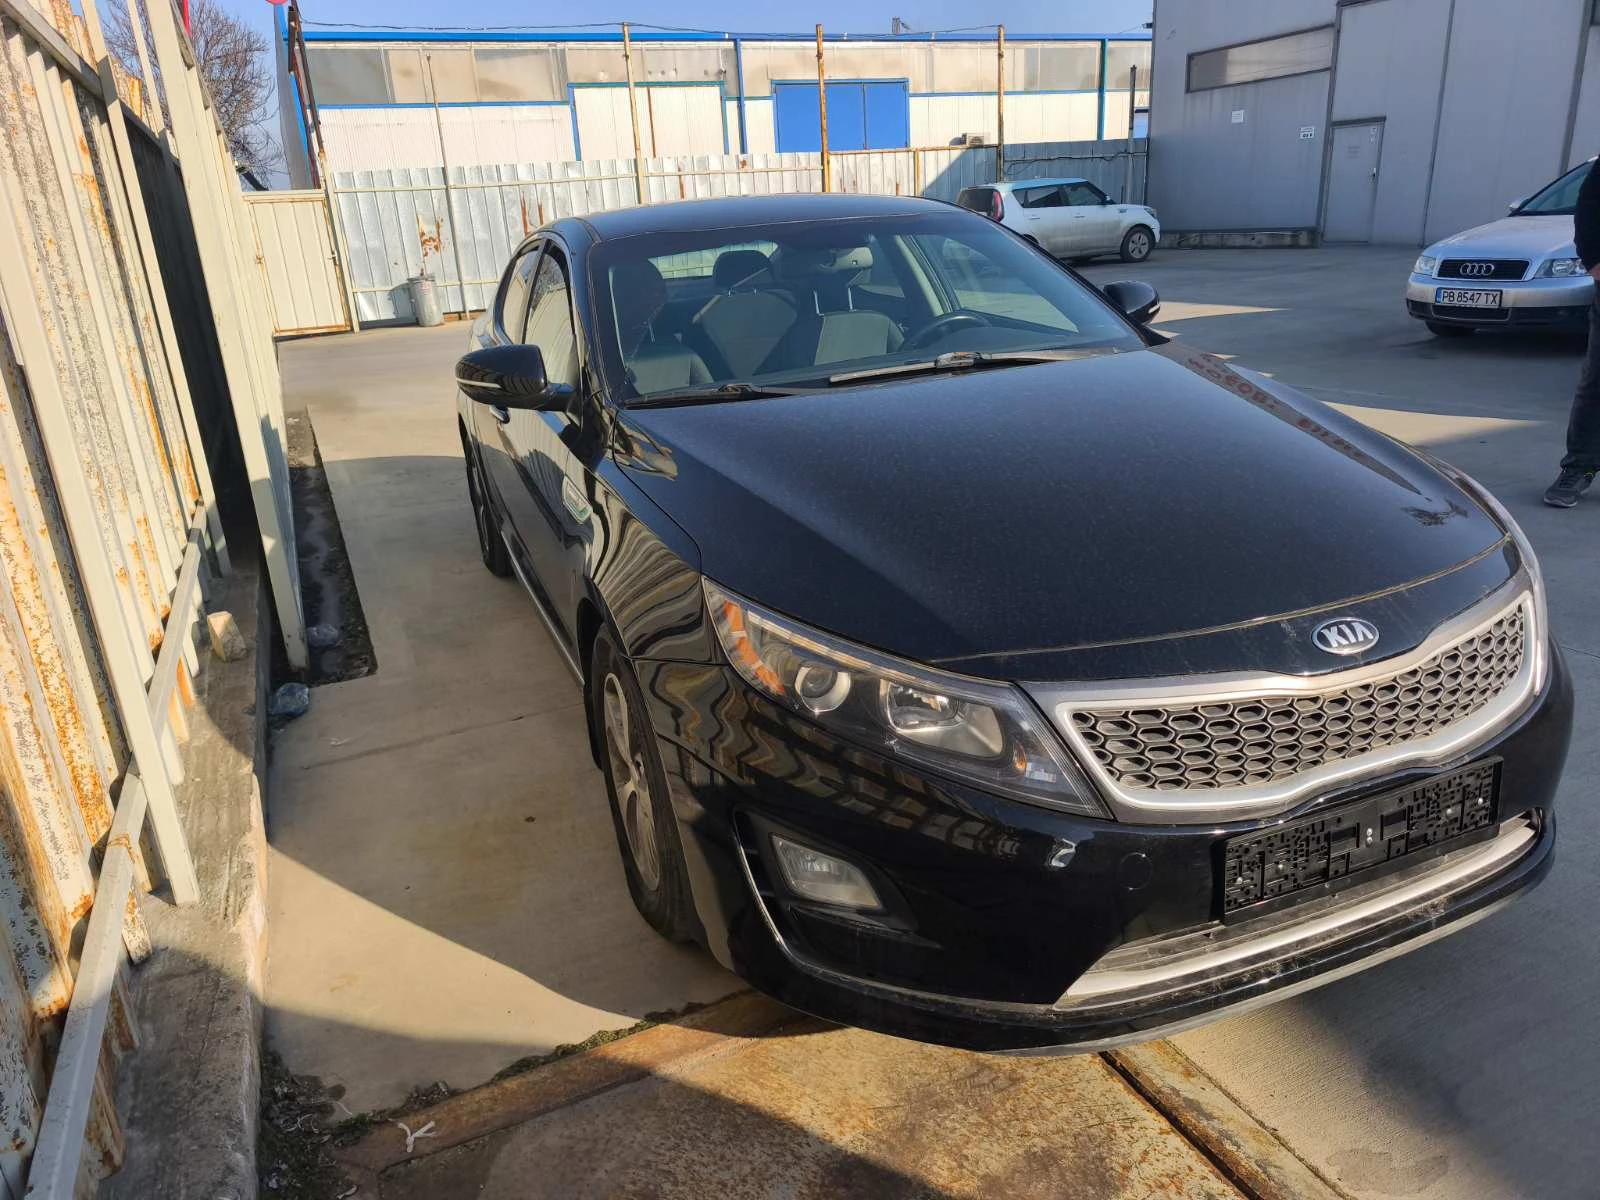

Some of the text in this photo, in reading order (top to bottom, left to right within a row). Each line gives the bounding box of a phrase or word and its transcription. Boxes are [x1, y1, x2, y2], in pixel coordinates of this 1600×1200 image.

[1442, 291, 1455, 302] PB
[1457, 292, 1482, 303] 8547
[1484, 293, 1498, 304] TX
[1320, 622, 1374, 648] KIA
